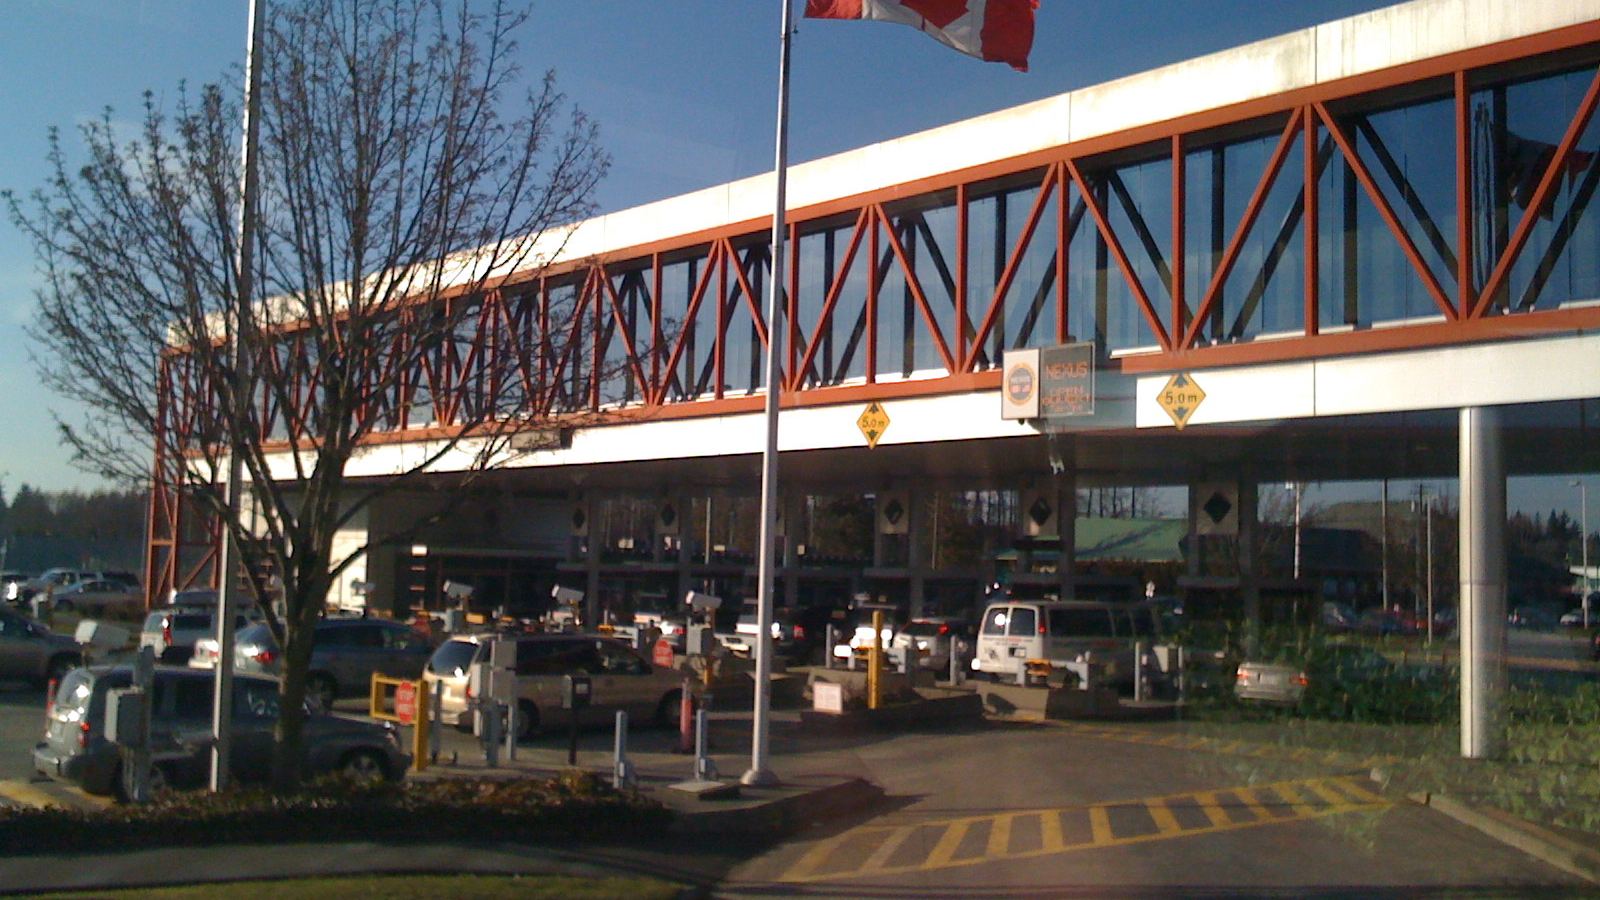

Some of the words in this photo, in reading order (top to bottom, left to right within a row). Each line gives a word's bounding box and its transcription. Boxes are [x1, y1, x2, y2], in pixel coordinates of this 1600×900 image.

[1046, 361, 1088, 379] NEXUS
[1165, 391, 1185, 405] 5.0
[1187, 394, 1198, 403] m
[862, 415, 877, 428] 5.0
